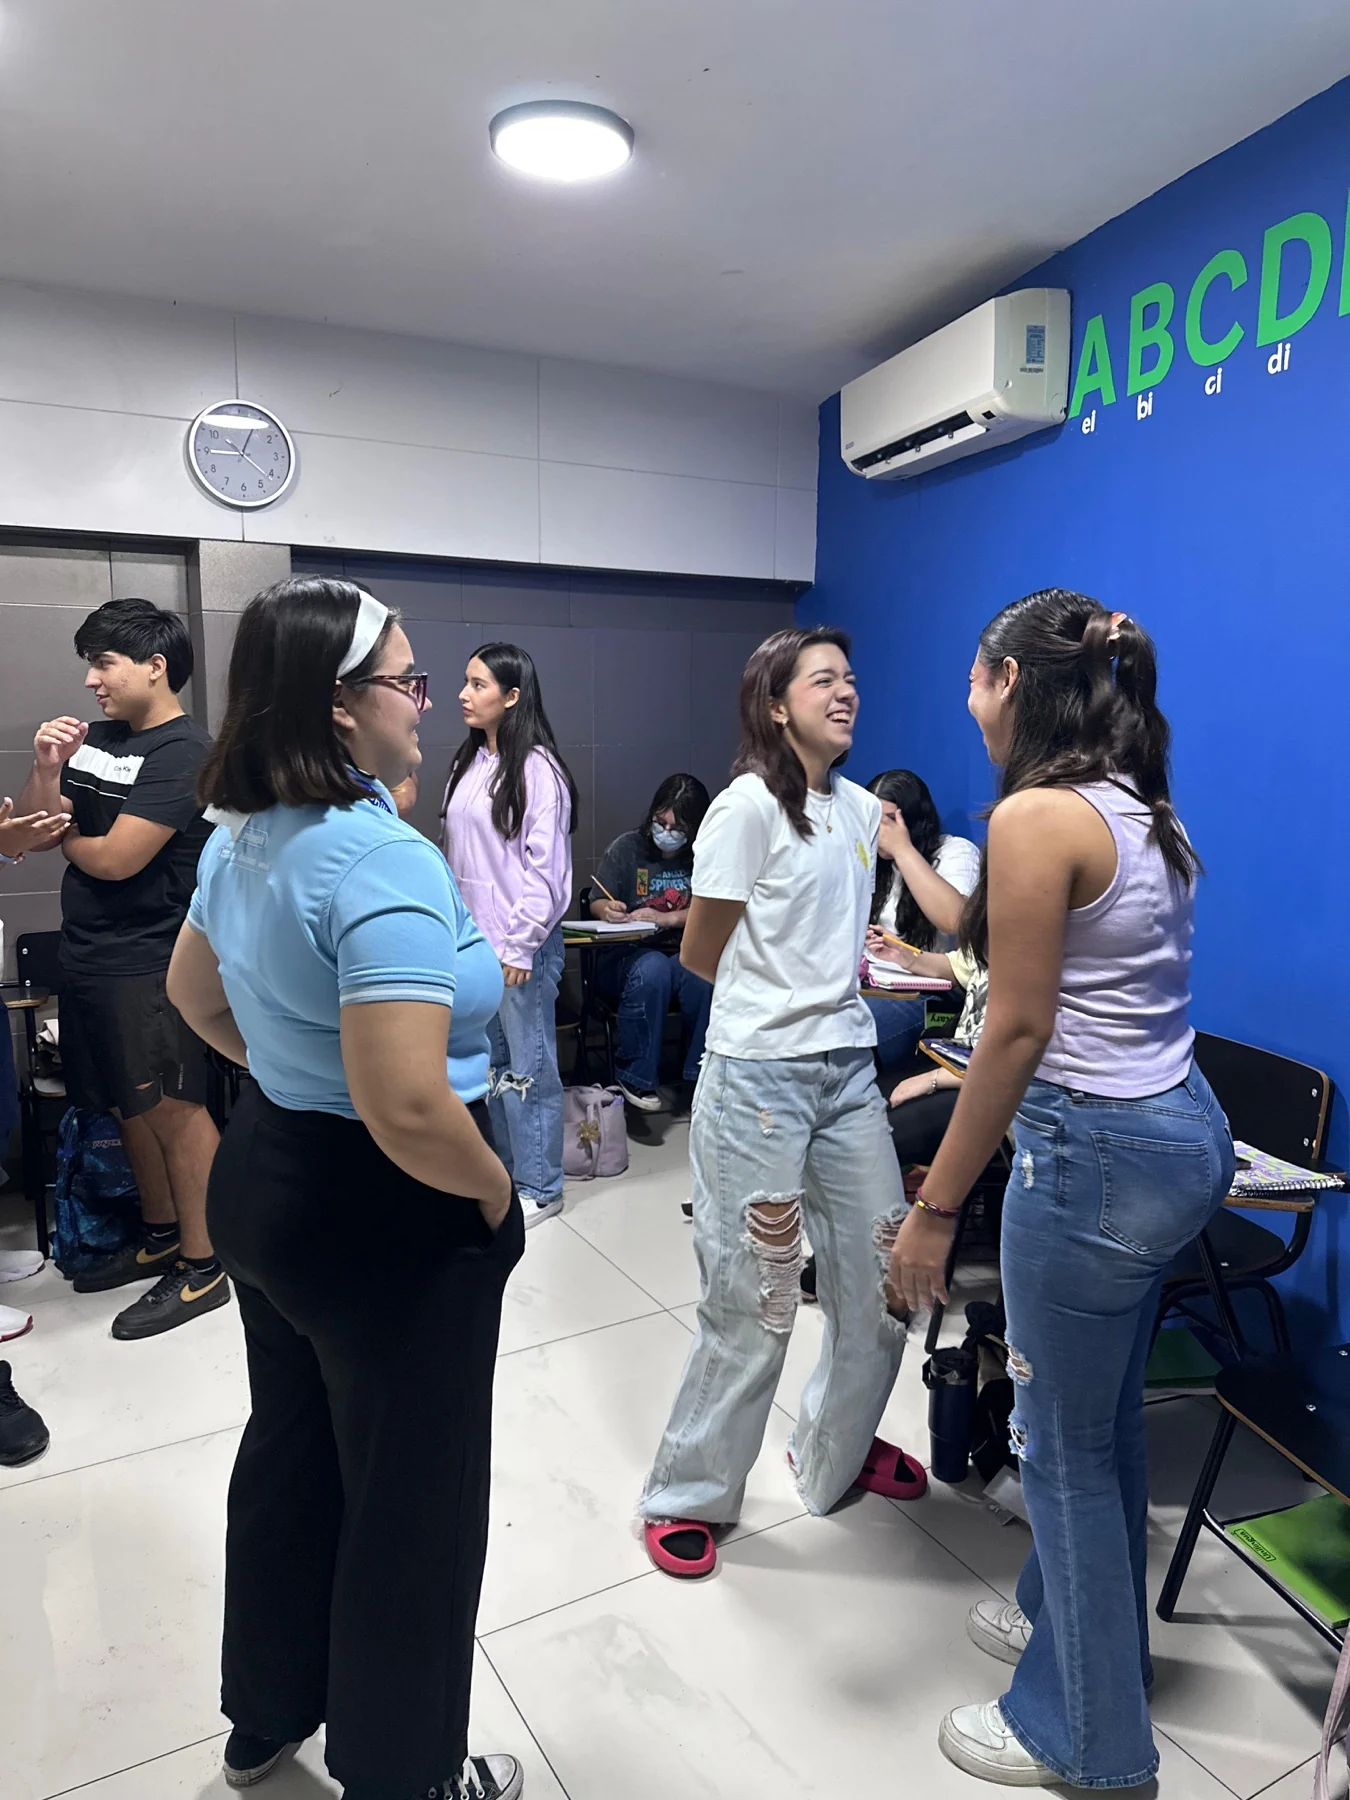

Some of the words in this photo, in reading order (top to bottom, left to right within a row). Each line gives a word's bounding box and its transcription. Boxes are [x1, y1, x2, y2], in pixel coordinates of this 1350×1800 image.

[1067, 188, 1350, 419] ABCD
[1136, 391, 1153, 420] bi
[1204, 367, 1222, 395] ci
[1267, 343, 1291, 374] di
[209, 429, 219, 439] 10
[266, 435, 272, 444] 2
[203, 446, 210, 455] 9
[273, 452, 279, 461] 3
[210, 464, 217, 473] 8
[268, 468, 274, 477] 4
[224, 476, 230, 486] 7
[257, 479, 264, 488] 5
[240, 482, 247, 491] 6
